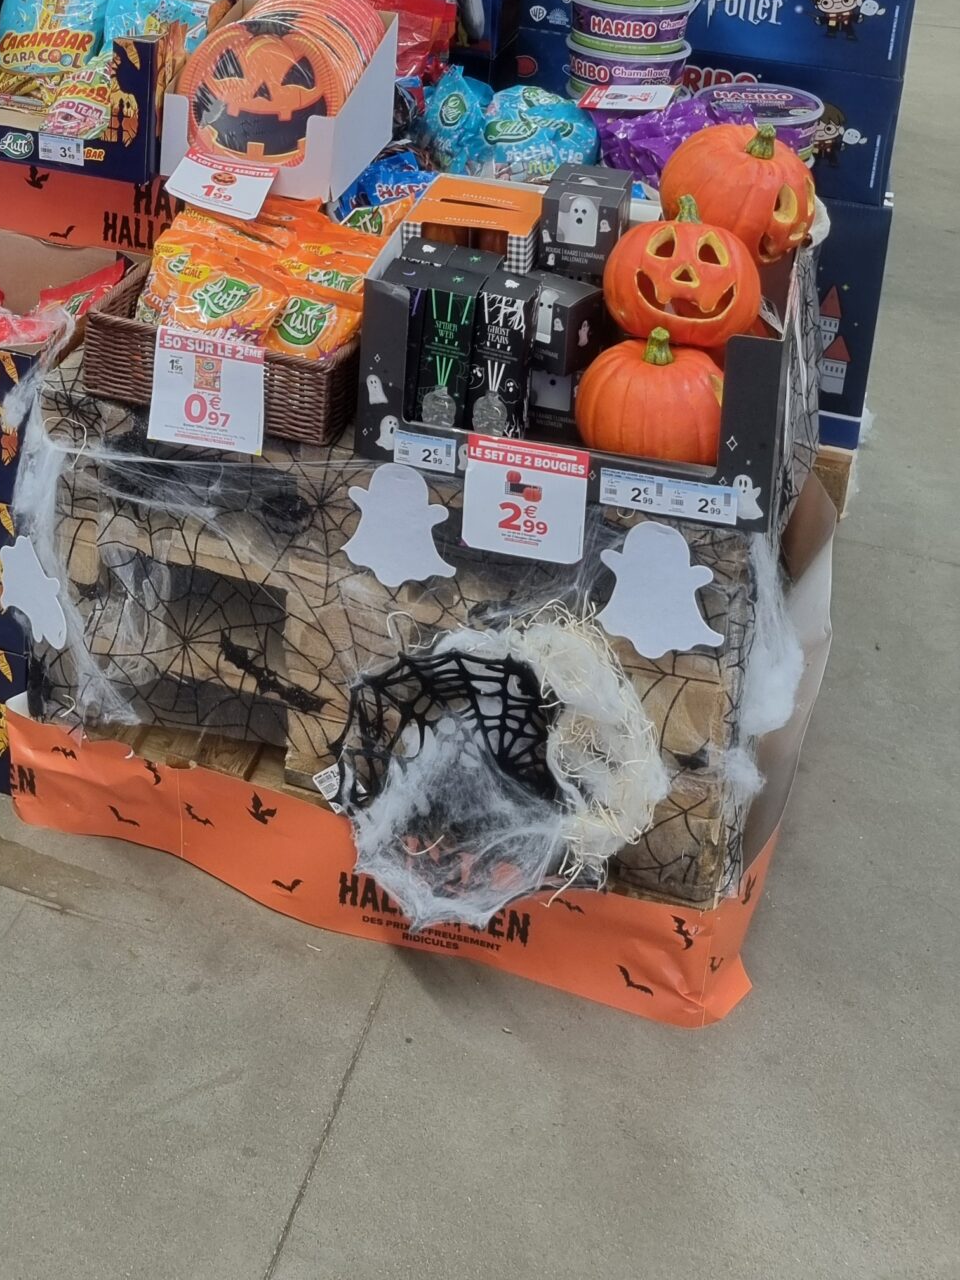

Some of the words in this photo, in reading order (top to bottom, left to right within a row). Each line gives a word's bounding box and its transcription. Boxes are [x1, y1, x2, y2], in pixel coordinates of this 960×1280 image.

[591, 16, 656, 40] HARIBO
[0, 30, 93, 53] CARAMBAR
[611, 67, 670, 79] Chamallows
[713, 90, 794, 101] HARIBO
[76, 103, 103, 119] TEAM
[0, 135, 31, 154] Lutti
[198, 157, 210, 166] LOT
[234, 167, 274, 177] ASSIETTES
[193, 277, 247, 317] Lutti
[276, 298, 318, 339] Lutti
[434, 320, 458, 331] SPIDER
[438, 330, 454, 340] WEB
[487, 325, 510, 337] GHOST
[487, 334, 509, 345] TEARS
[187, 337, 214, 353] SUR
[218, 343, 232, 356] LE
[235, 344, 263, 359] 2ÈME
[184, 394, 230, 427] 0€97
[470, 446, 482, 458] LE
[484, 448, 504, 462] SET
[507, 452, 520, 464] DE
[523, 454, 532, 465] 2
[534, 456, 585, 474] BOUGIES
[498, 501, 548, 535] 2€99
[362, 915, 383, 926] DES
[385, 919, 409, 931] PRIX
[402, 932, 459, 950] RIDICULES
